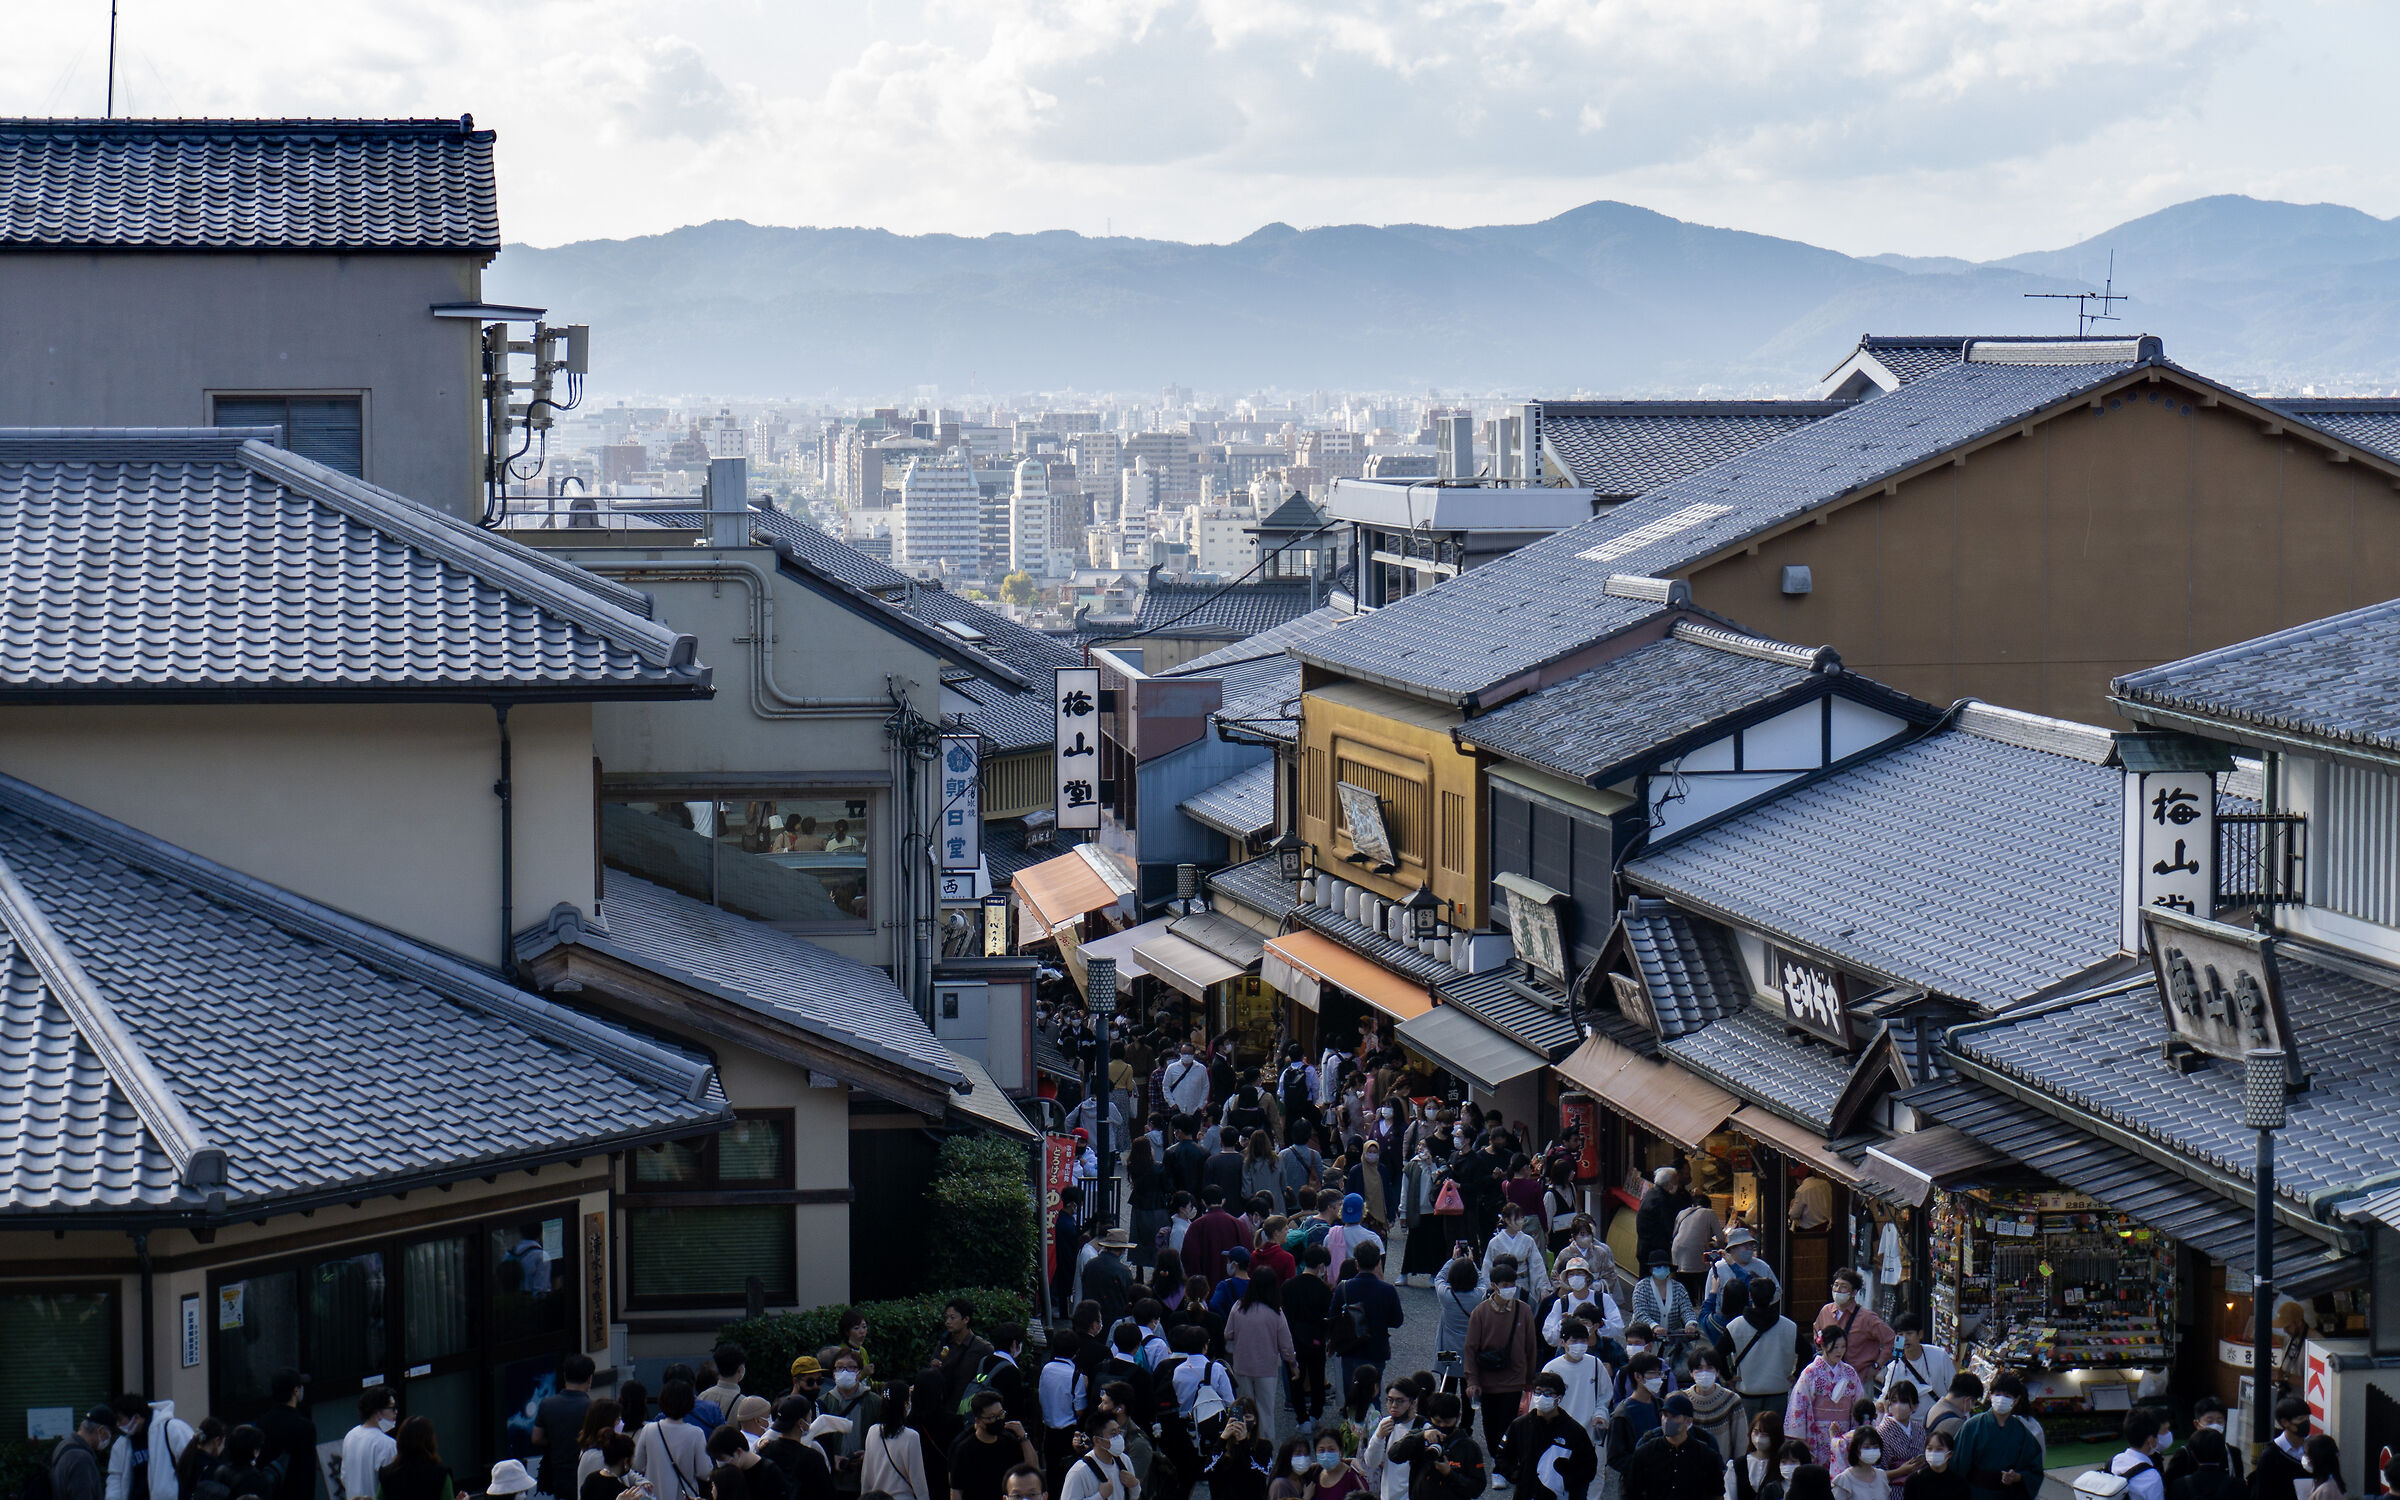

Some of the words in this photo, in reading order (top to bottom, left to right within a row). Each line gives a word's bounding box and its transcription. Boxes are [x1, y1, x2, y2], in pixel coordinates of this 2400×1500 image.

[1062, 690, 1097, 808] 梅山堂
[945, 778, 967, 859] 朝日堂
[943, 878, 958, 894] 西
